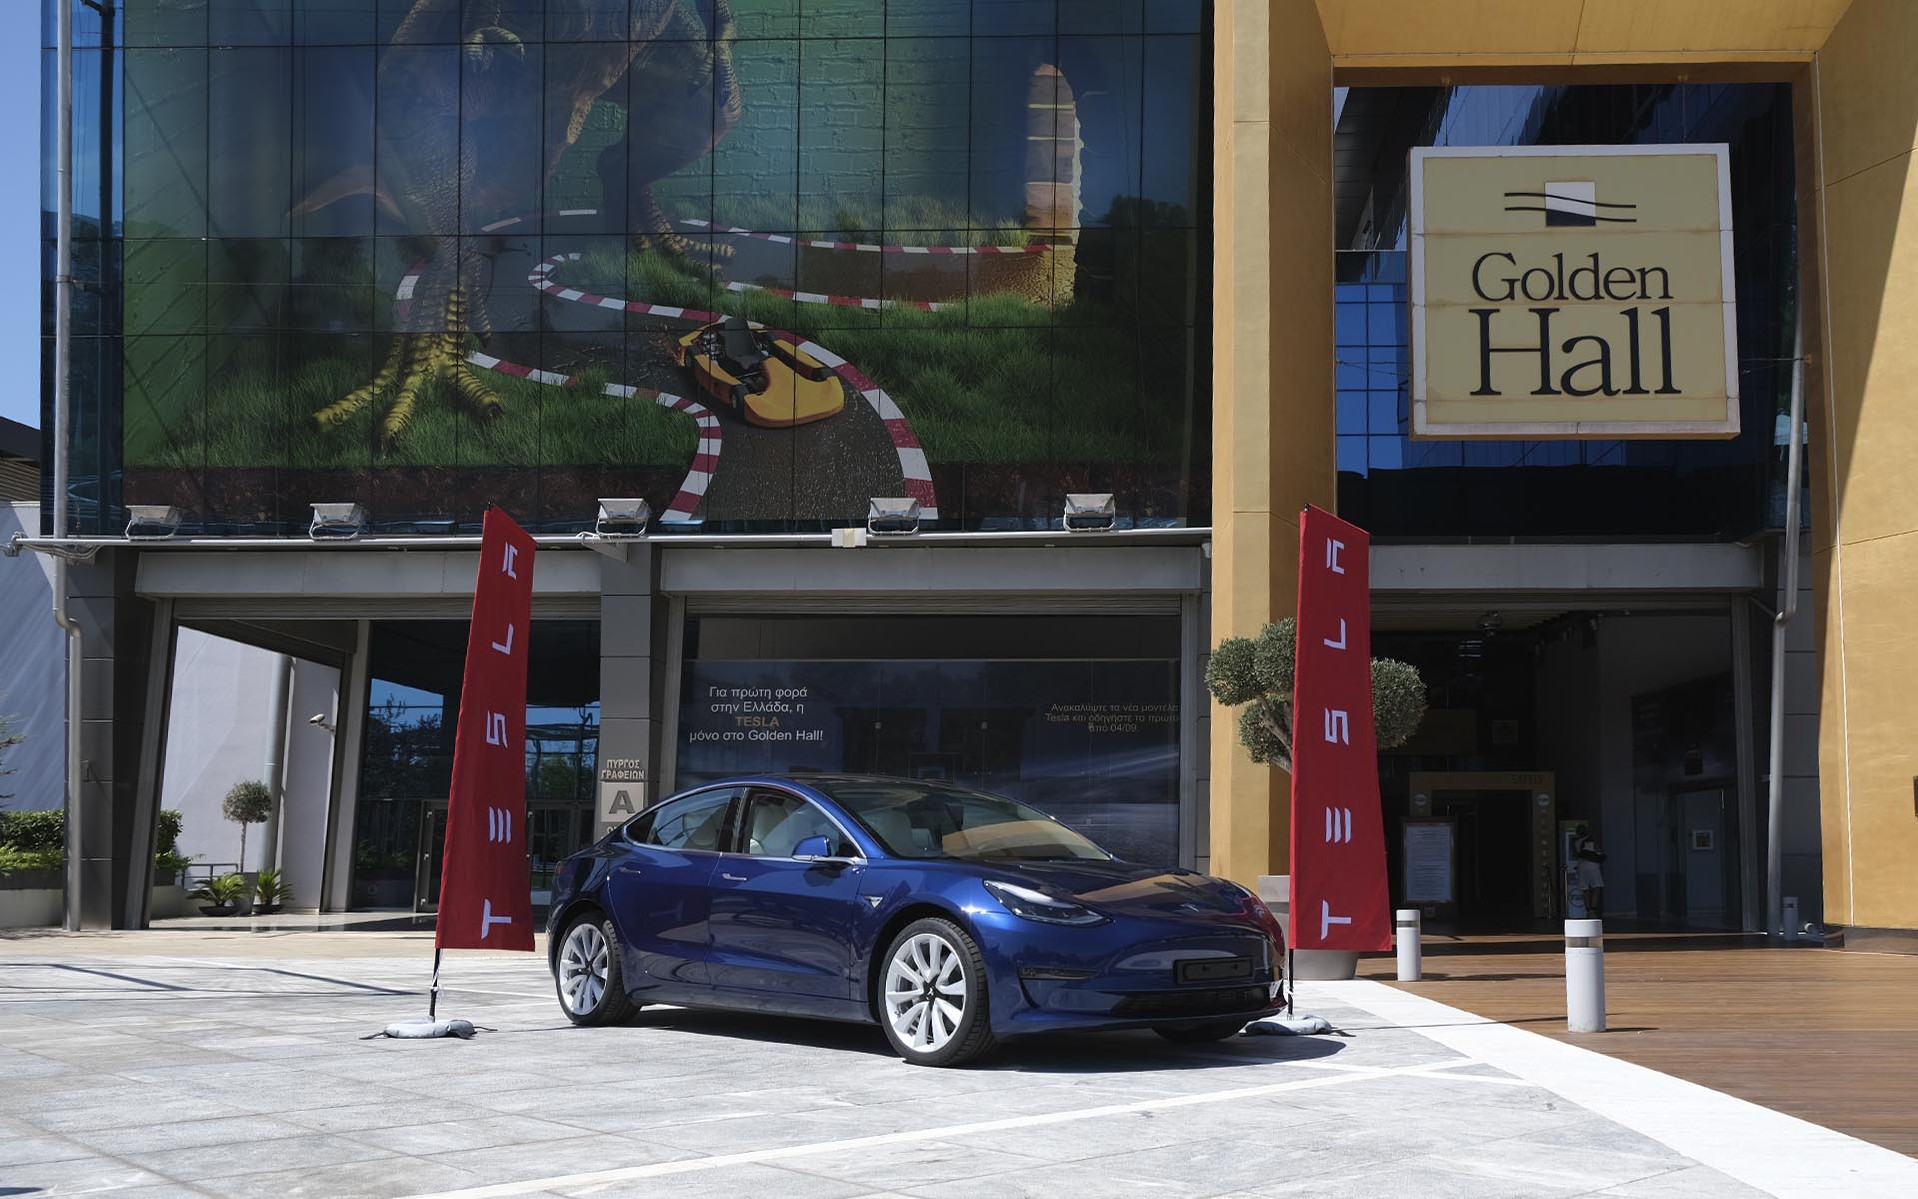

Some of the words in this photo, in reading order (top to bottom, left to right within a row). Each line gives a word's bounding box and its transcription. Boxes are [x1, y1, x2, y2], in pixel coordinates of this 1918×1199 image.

[1472, 252, 1674, 302] Golden
[1468, 306, 1682, 397] Hall
[709, 686, 728, 698] Για
[731, 686, 772, 700] πρώτη
[775, 687, 808, 700] φορά
[710, 703, 740, 715] στην
[743, 701, 793, 714] Ελλάδα,
[796, 703, 805, 715] η
[735, 716, 780, 727] TESLA
[1045, 712, 1070, 722] Tesla
[481, 541, 518, 940] TESLA
[689, 730, 720, 743] μόνο
[723, 731, 745, 741] στο
[748, 729, 792, 741] Golden
[796, 729, 824, 741] Hall!
[1320, 537, 1352, 940] TESLA
[606, 759, 640, 769] ΠΥΡΓΟΣ
[601, 770, 645, 780] ΓΡΑΦΕΙΩΝ
